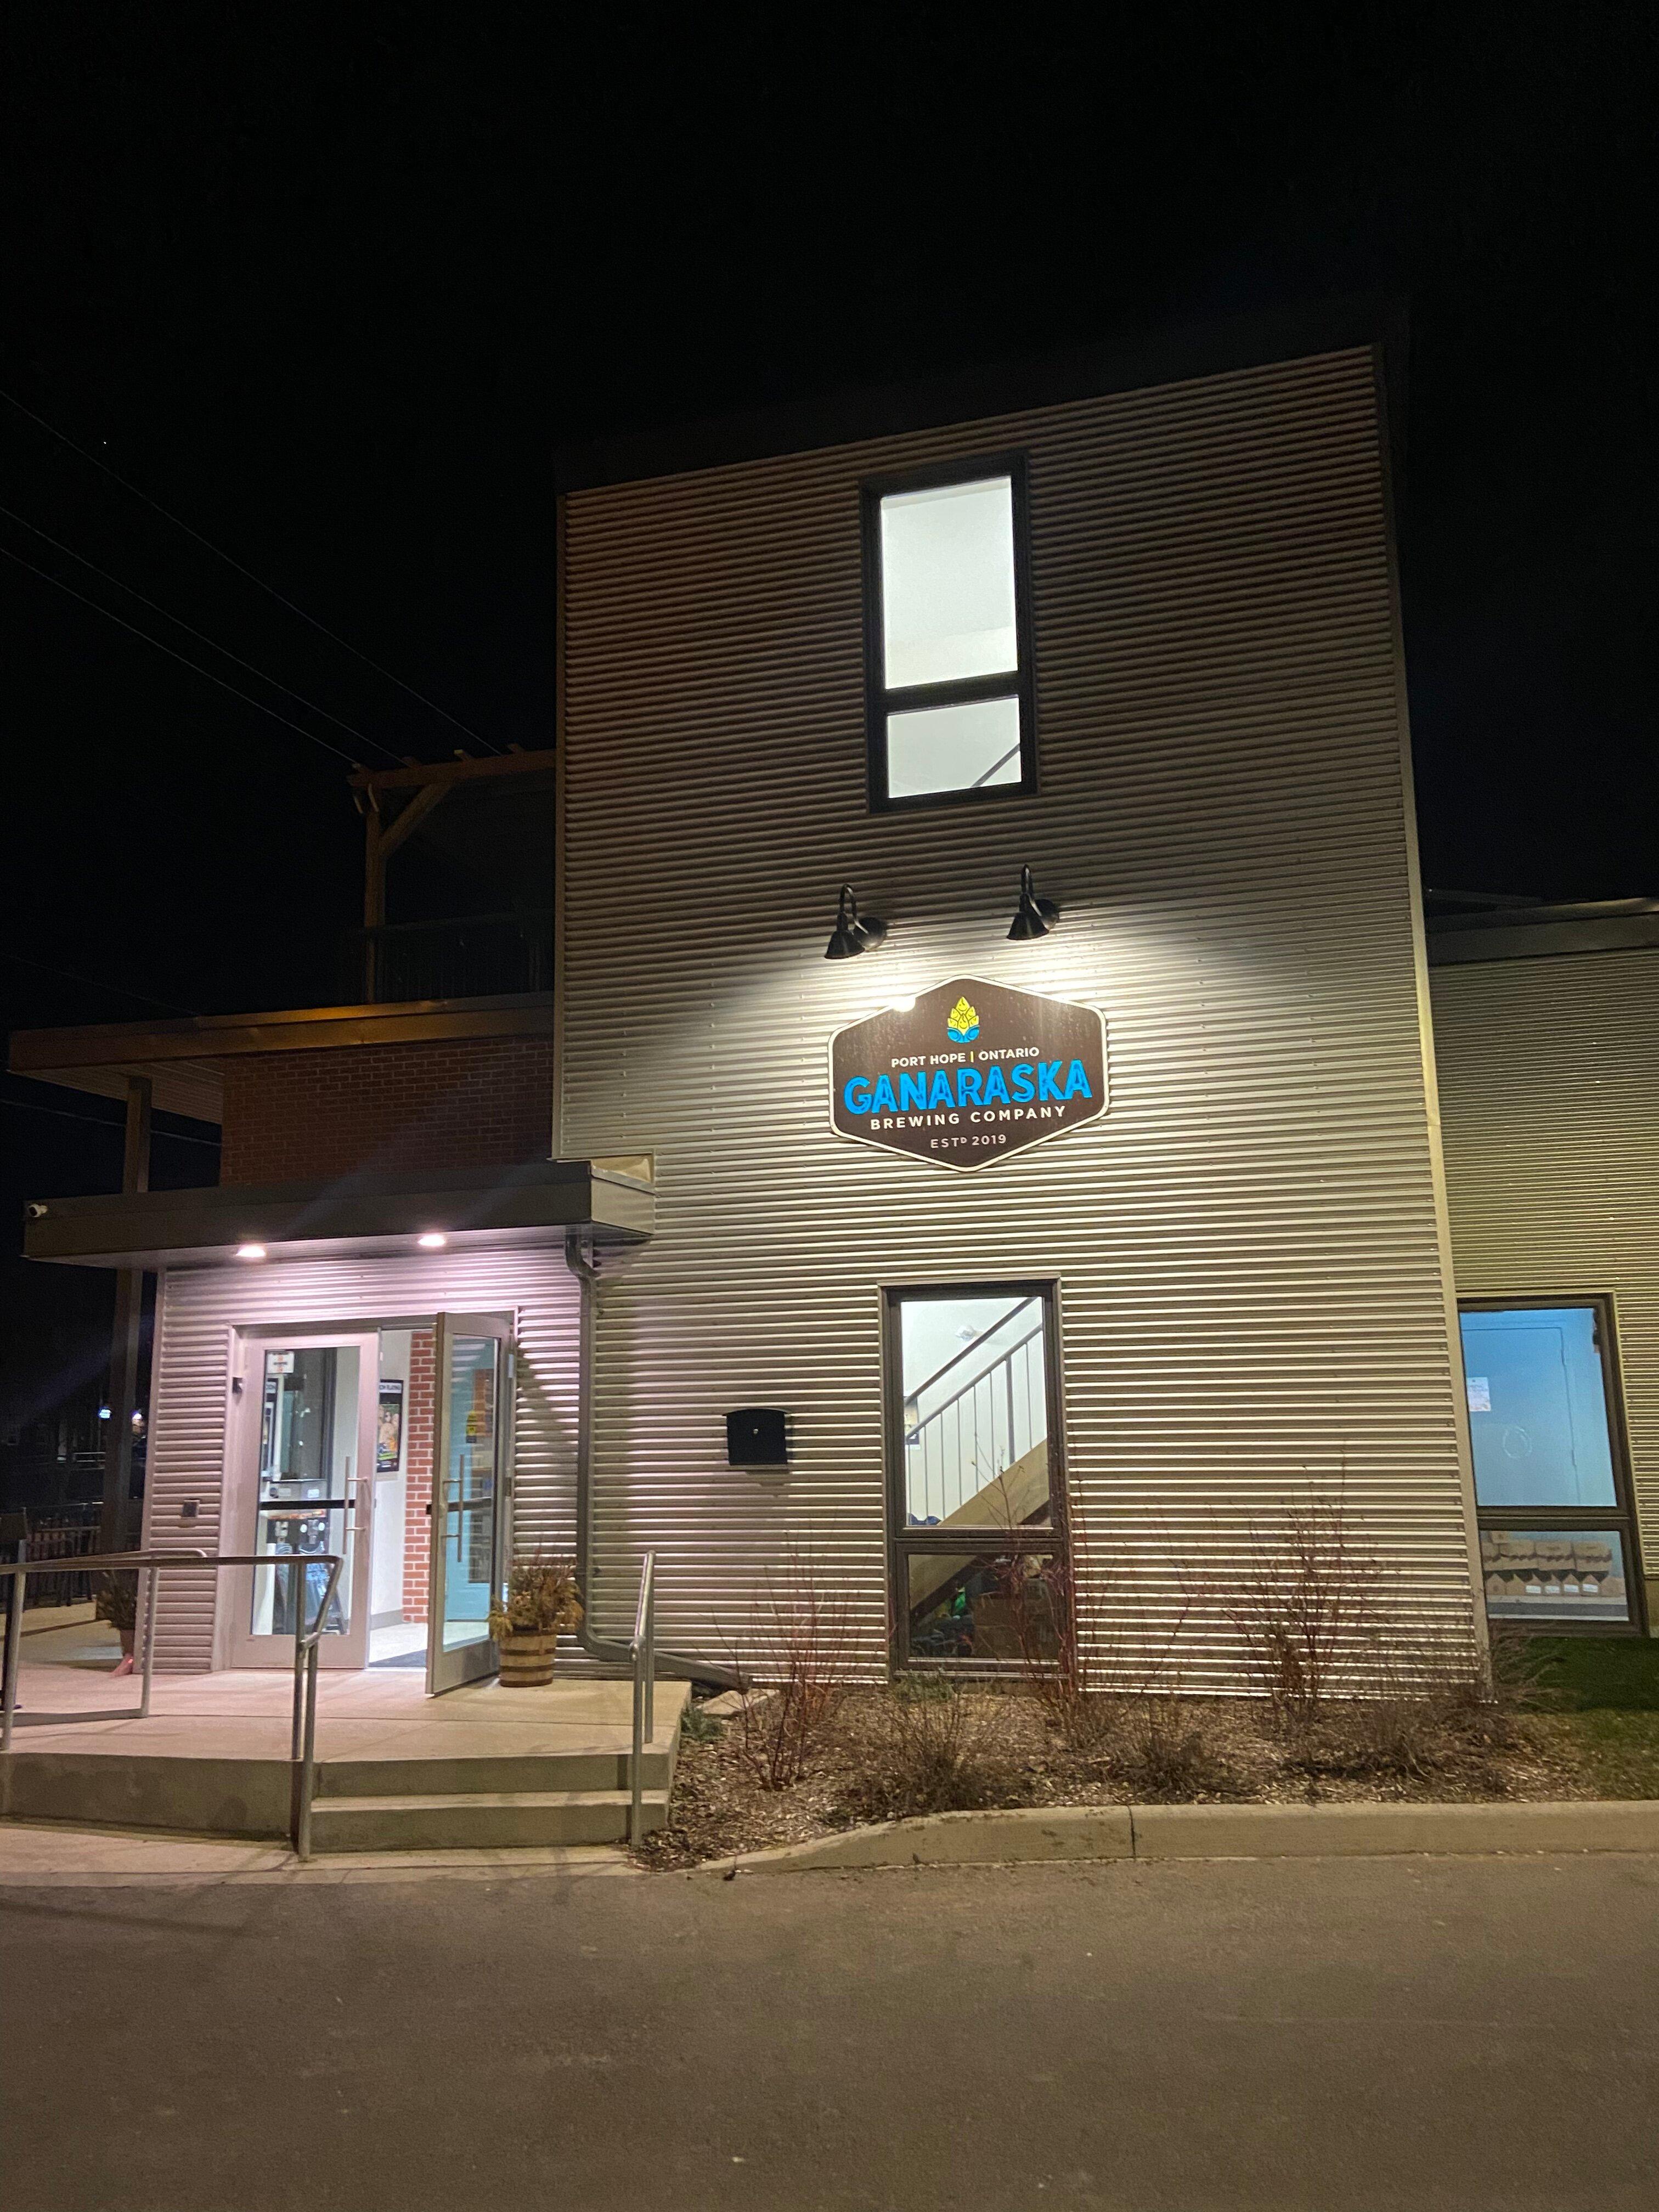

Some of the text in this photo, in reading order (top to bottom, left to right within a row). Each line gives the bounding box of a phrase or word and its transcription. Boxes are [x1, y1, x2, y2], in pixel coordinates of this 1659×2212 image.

[891, 1056, 927, 1068] PORT
[929, 1053, 966, 1065] HOPE
[978, 1047, 1040, 1061] ONTARIO
[844, 1059, 1092, 1115] GANARASKA
[870, 1105, 1065, 1130] BREWING COMPANY
[972, 1134, 1007, 1146] 2019
